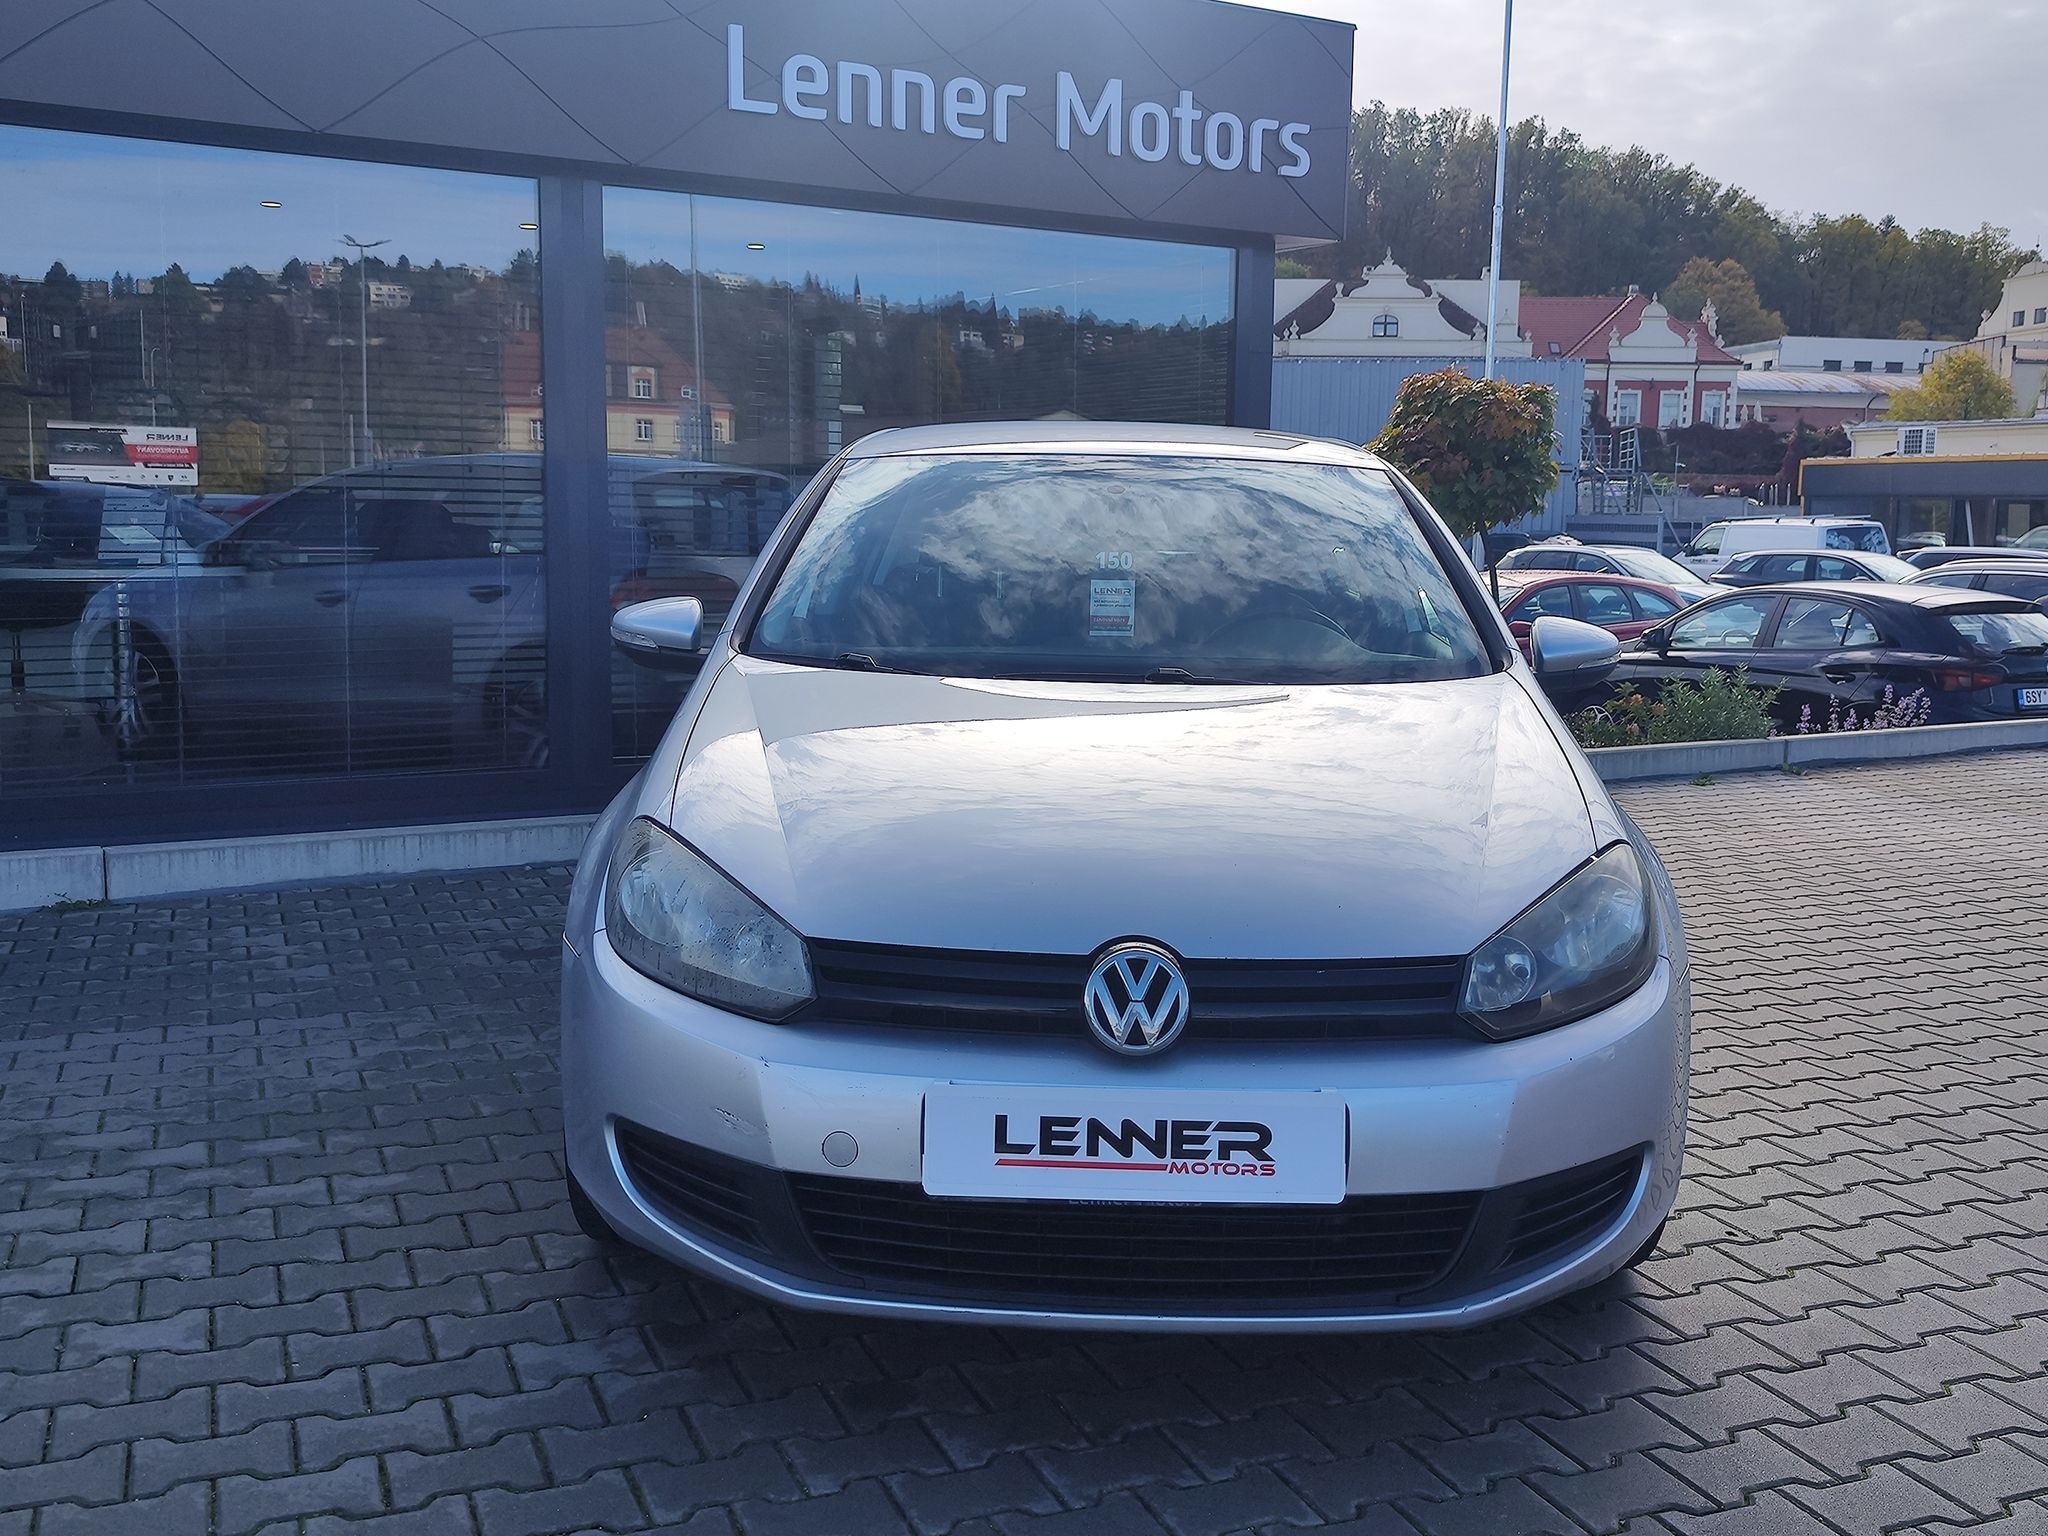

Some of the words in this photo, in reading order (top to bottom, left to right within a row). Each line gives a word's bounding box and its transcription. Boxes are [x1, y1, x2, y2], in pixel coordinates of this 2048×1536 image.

[726, 23, 1027, 143] Lenner
[1056, 70, 1312, 178] Motors
[1095, 551, 1133, 569] 150
[1093, 587, 1132, 596] LENNER
[994, 1114, 1276, 1162] LENNER
[1168, 1162, 1276, 1177] MOTORS
